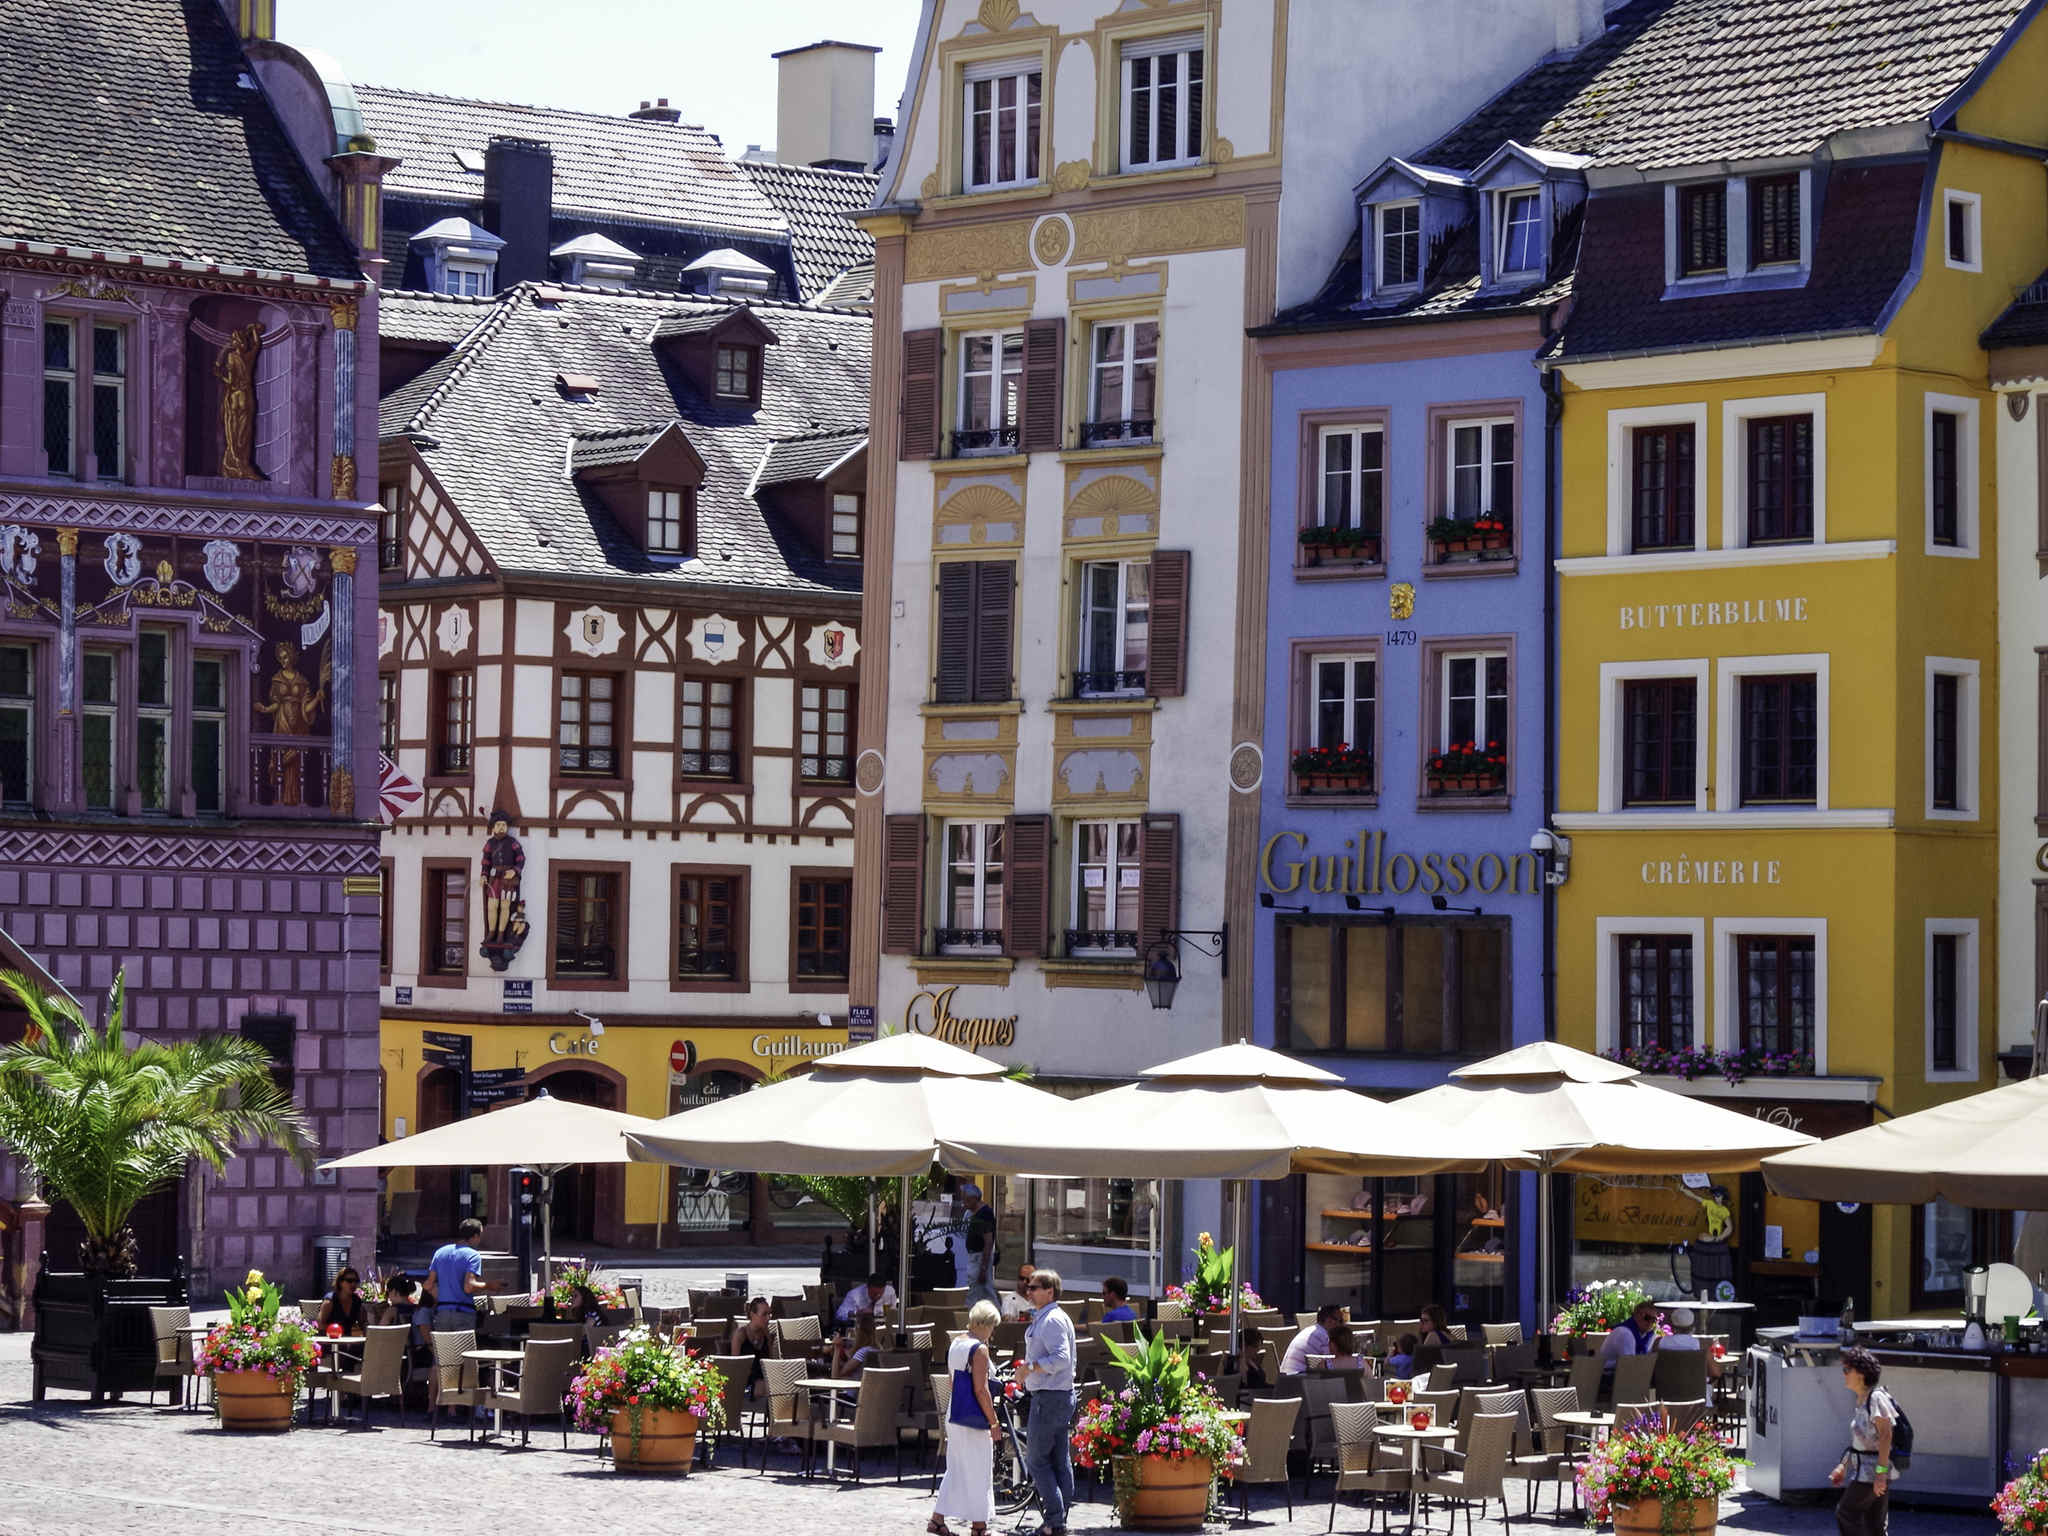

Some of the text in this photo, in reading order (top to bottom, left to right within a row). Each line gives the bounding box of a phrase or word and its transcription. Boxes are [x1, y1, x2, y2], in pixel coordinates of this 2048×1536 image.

[1619, 597, 1808, 630] BUTTERBLUME
[1387, 630, 1417, 646] 1479
[1260, 829, 1540, 895] Guillosson
[1641, 852, 1781, 884] CRÊMERIE
[904, 985, 1018, 1053] Jacques
[549, 1032, 848, 1057] Café Guillaum
